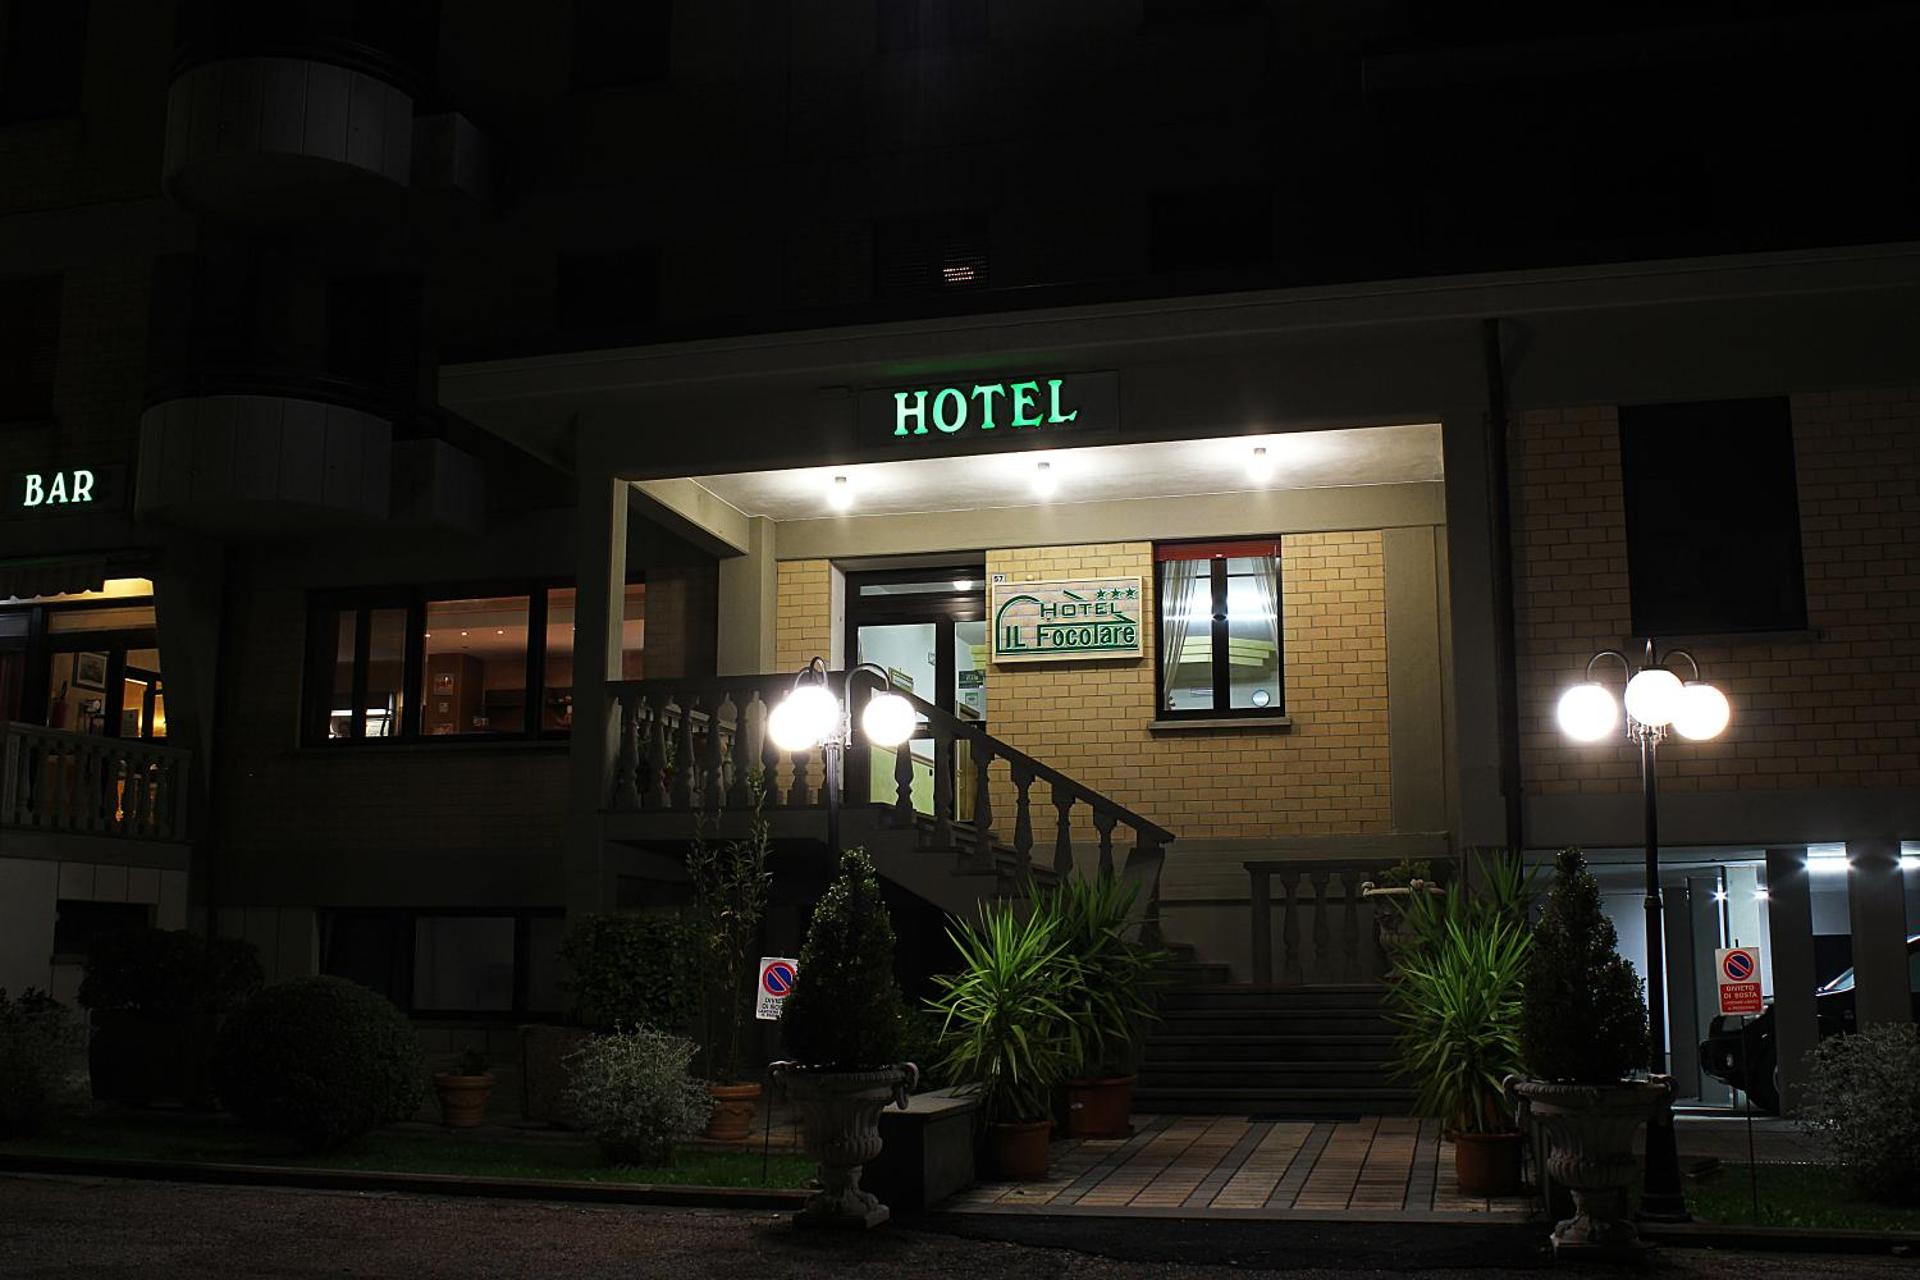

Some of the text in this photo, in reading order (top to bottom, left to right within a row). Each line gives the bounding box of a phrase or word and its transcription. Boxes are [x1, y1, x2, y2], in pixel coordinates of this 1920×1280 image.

[894, 379, 1077, 436] HOTEL
[23, 470, 94, 506] BAR
[994, 575, 1003, 583] 57
[1040, 602, 1122, 617] HOTEL
[1006, 625, 1026, 648] IL
